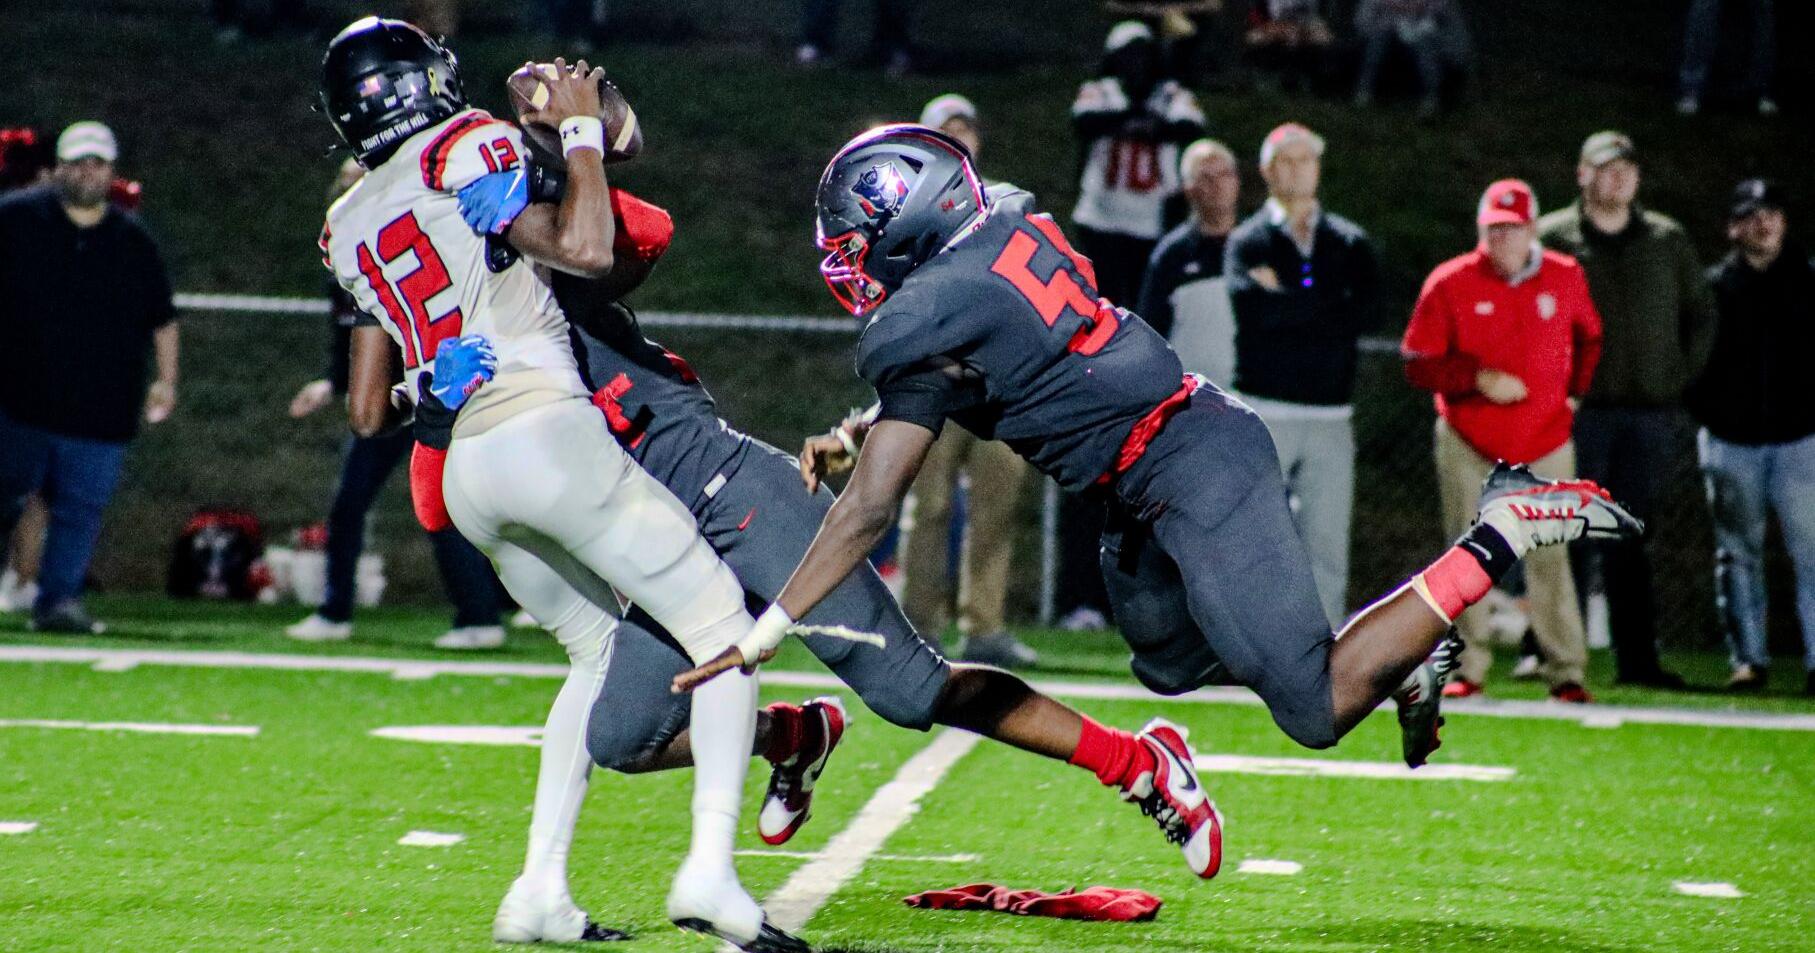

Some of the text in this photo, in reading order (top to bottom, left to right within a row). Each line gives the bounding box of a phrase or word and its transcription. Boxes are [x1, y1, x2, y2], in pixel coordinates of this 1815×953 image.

[361, 134, 380, 151] FIGHT
[380, 128, 397, 143] FOR
[394, 120, 412, 137] THE
[478, 137, 519, 173] 12
[1103, 141, 1160, 192] 10
[357, 209, 463, 370] 12
